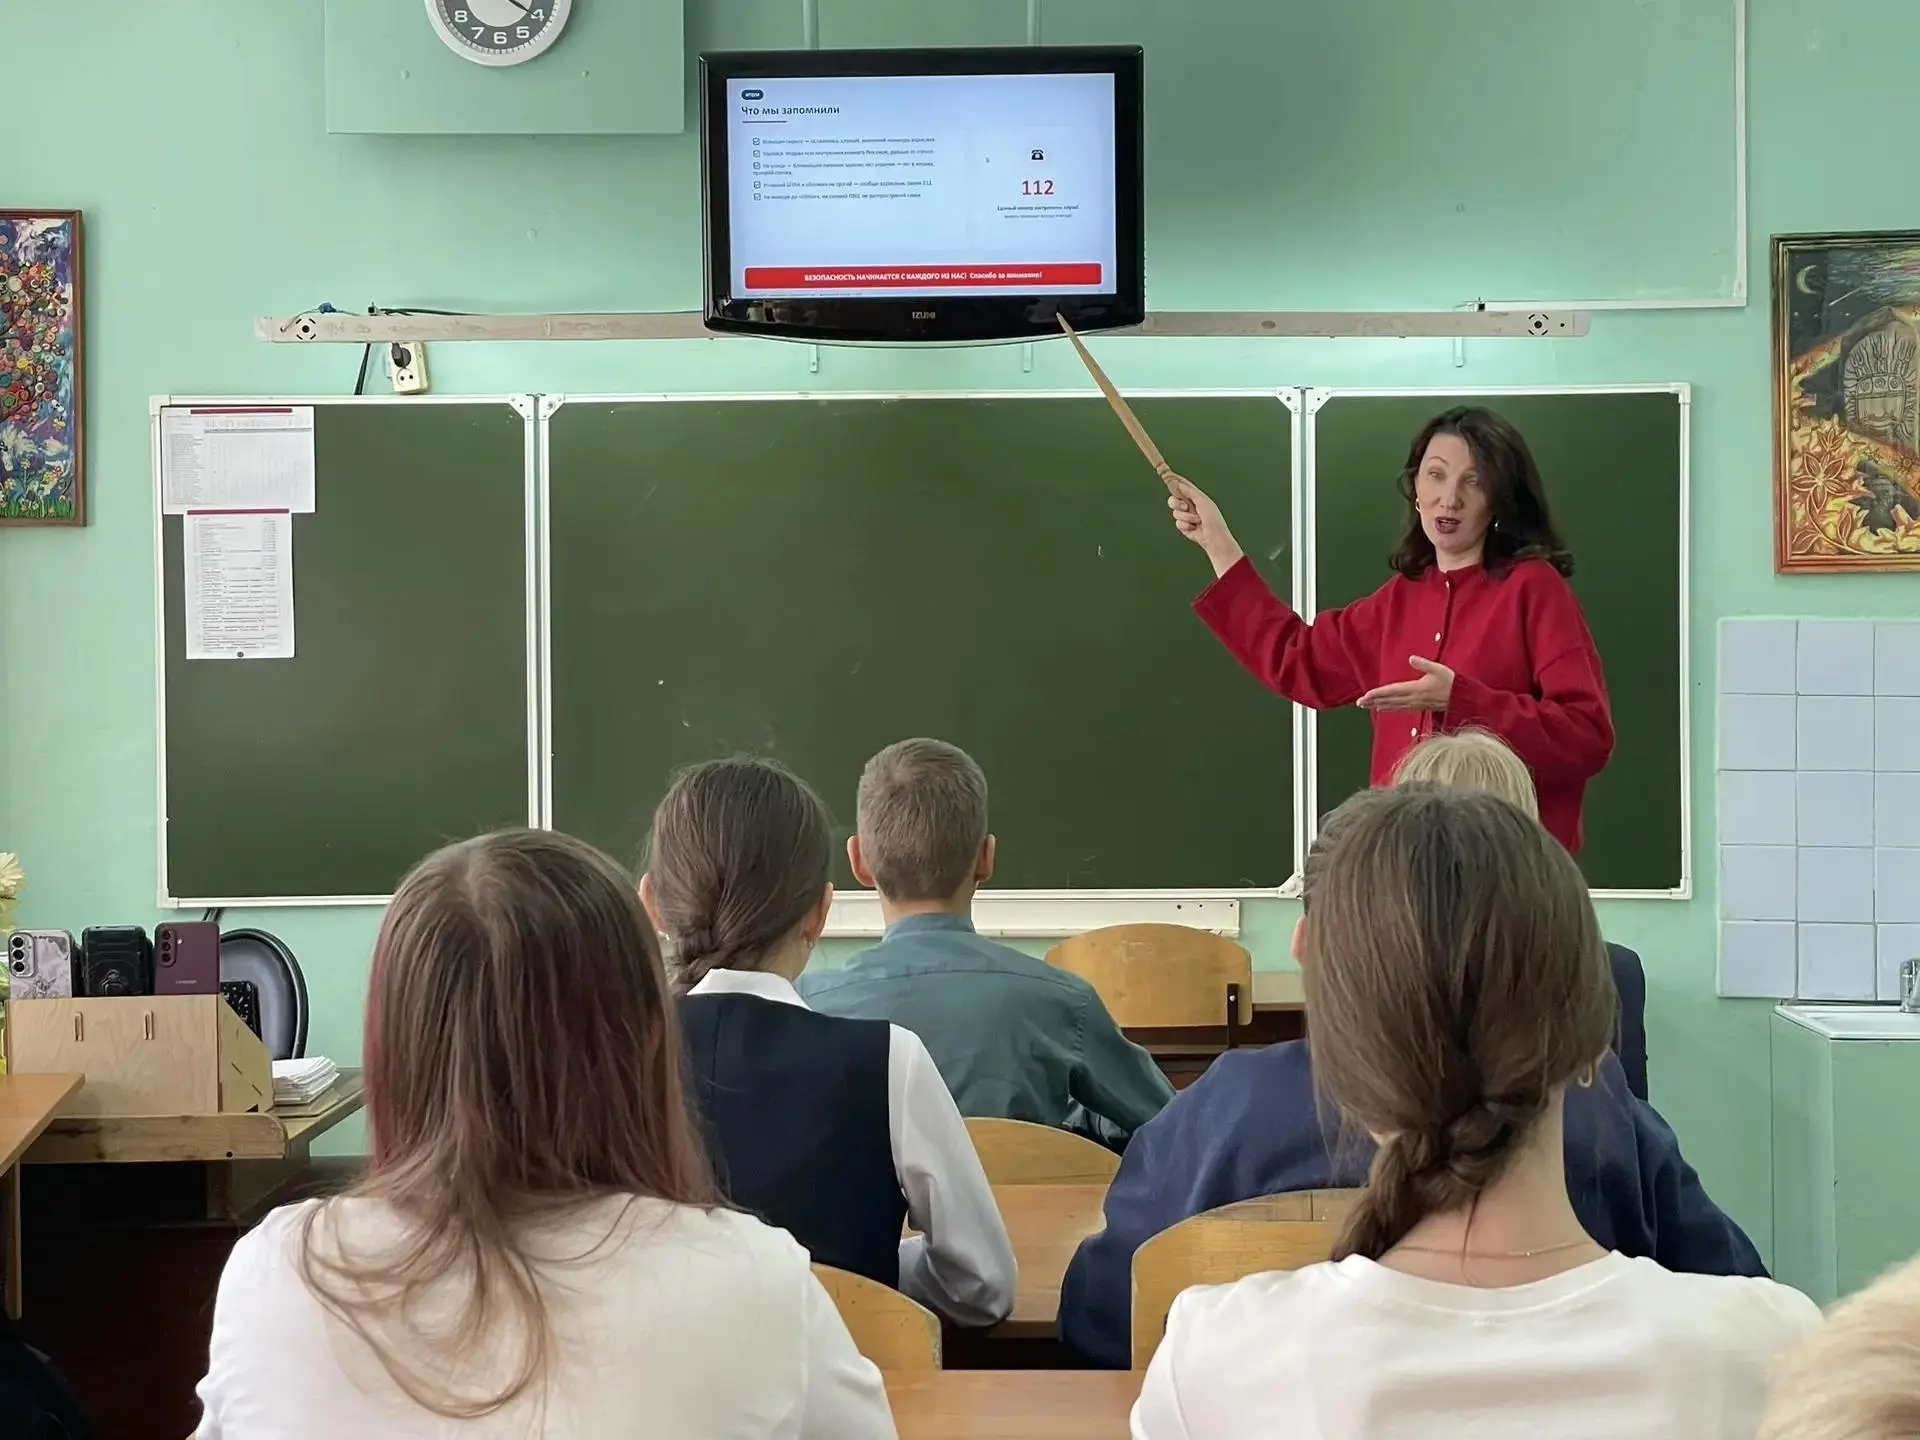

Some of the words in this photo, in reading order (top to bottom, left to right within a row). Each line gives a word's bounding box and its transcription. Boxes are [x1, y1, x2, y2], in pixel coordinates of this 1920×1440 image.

[454, 10, 468, 23] 8
[530, 8, 545, 21] 4
[471, 26, 485, 40] 7
[493, 31, 508, 45] 6
[516, 26, 530, 39] 5
[741, 106, 760, 115] Что
[761, 107, 779, 115] мы
[782, 106, 840, 115] запомнили
[1022, 179, 1055, 196] 112
[804, 273, 856, 282] БЕЗОПАСНОСТЬ
[856, 273, 900, 281] НАЧИНАЕТСЯ
[906, 272, 940, 281] КАЖДОГО
[940, 272, 950, 280] ИЗ
[969, 271, 998, 279] Спасибо
